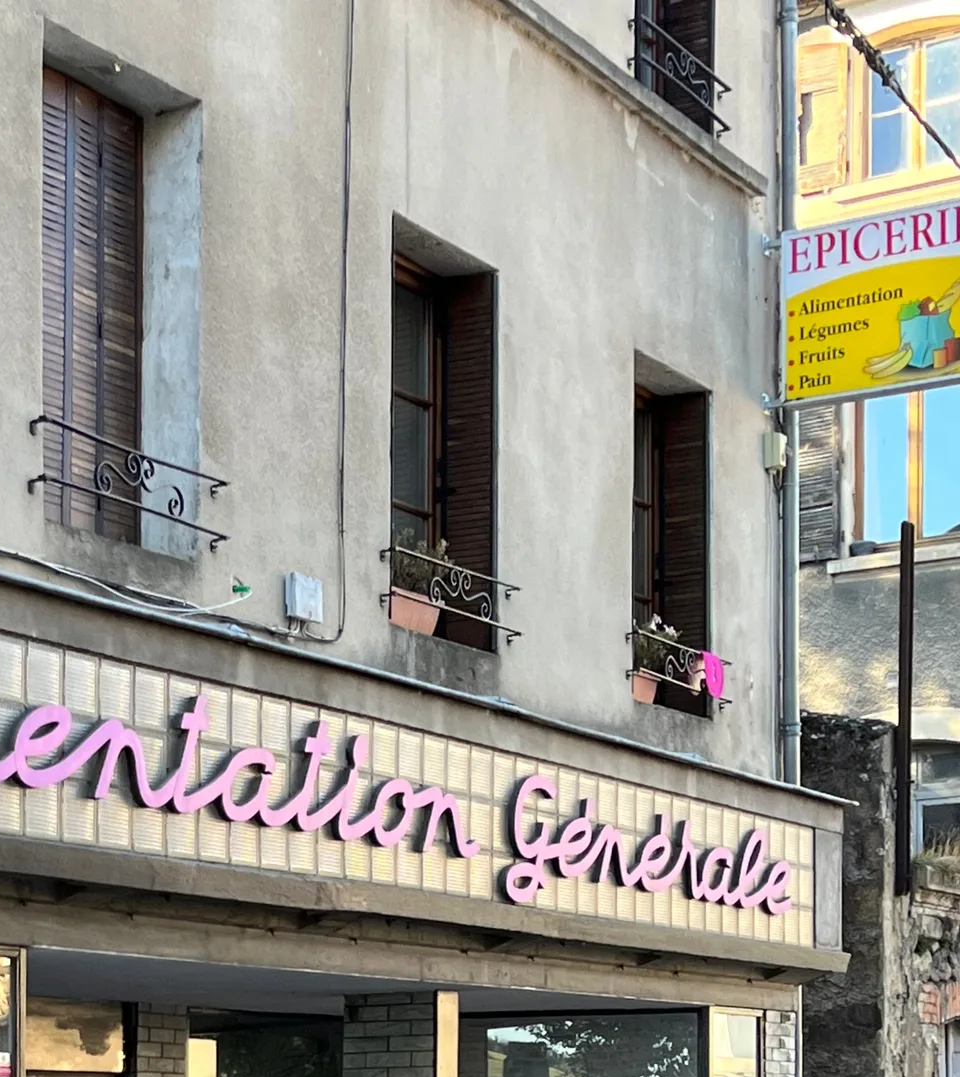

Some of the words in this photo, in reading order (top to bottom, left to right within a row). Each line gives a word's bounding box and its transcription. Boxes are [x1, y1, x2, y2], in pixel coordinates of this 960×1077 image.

[788, 205, 960, 275] EPICERI
[798, 286, 903, 317] Alimentation
[799, 318, 870, 342] Légumes
[799, 346, 845, 366] Fruits
[799, 373, 832, 391] Pain
